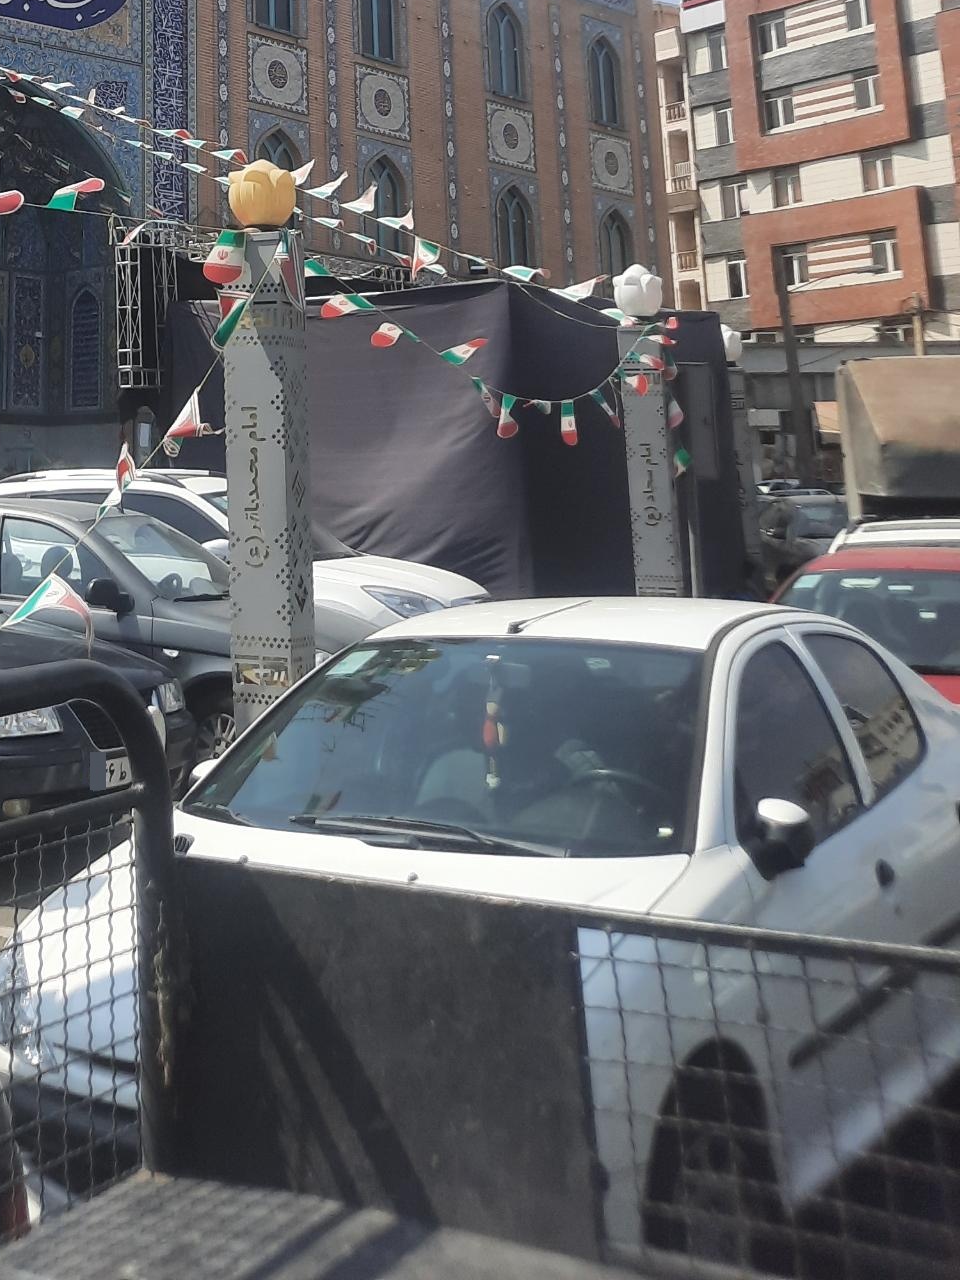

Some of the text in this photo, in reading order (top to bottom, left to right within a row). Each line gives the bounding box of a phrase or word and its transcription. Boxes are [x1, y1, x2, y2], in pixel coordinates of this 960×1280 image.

[241, 406, 267, 442] امام
[638, 443, 659, 466] امام
[642, 469, 656, 503] سجاد
